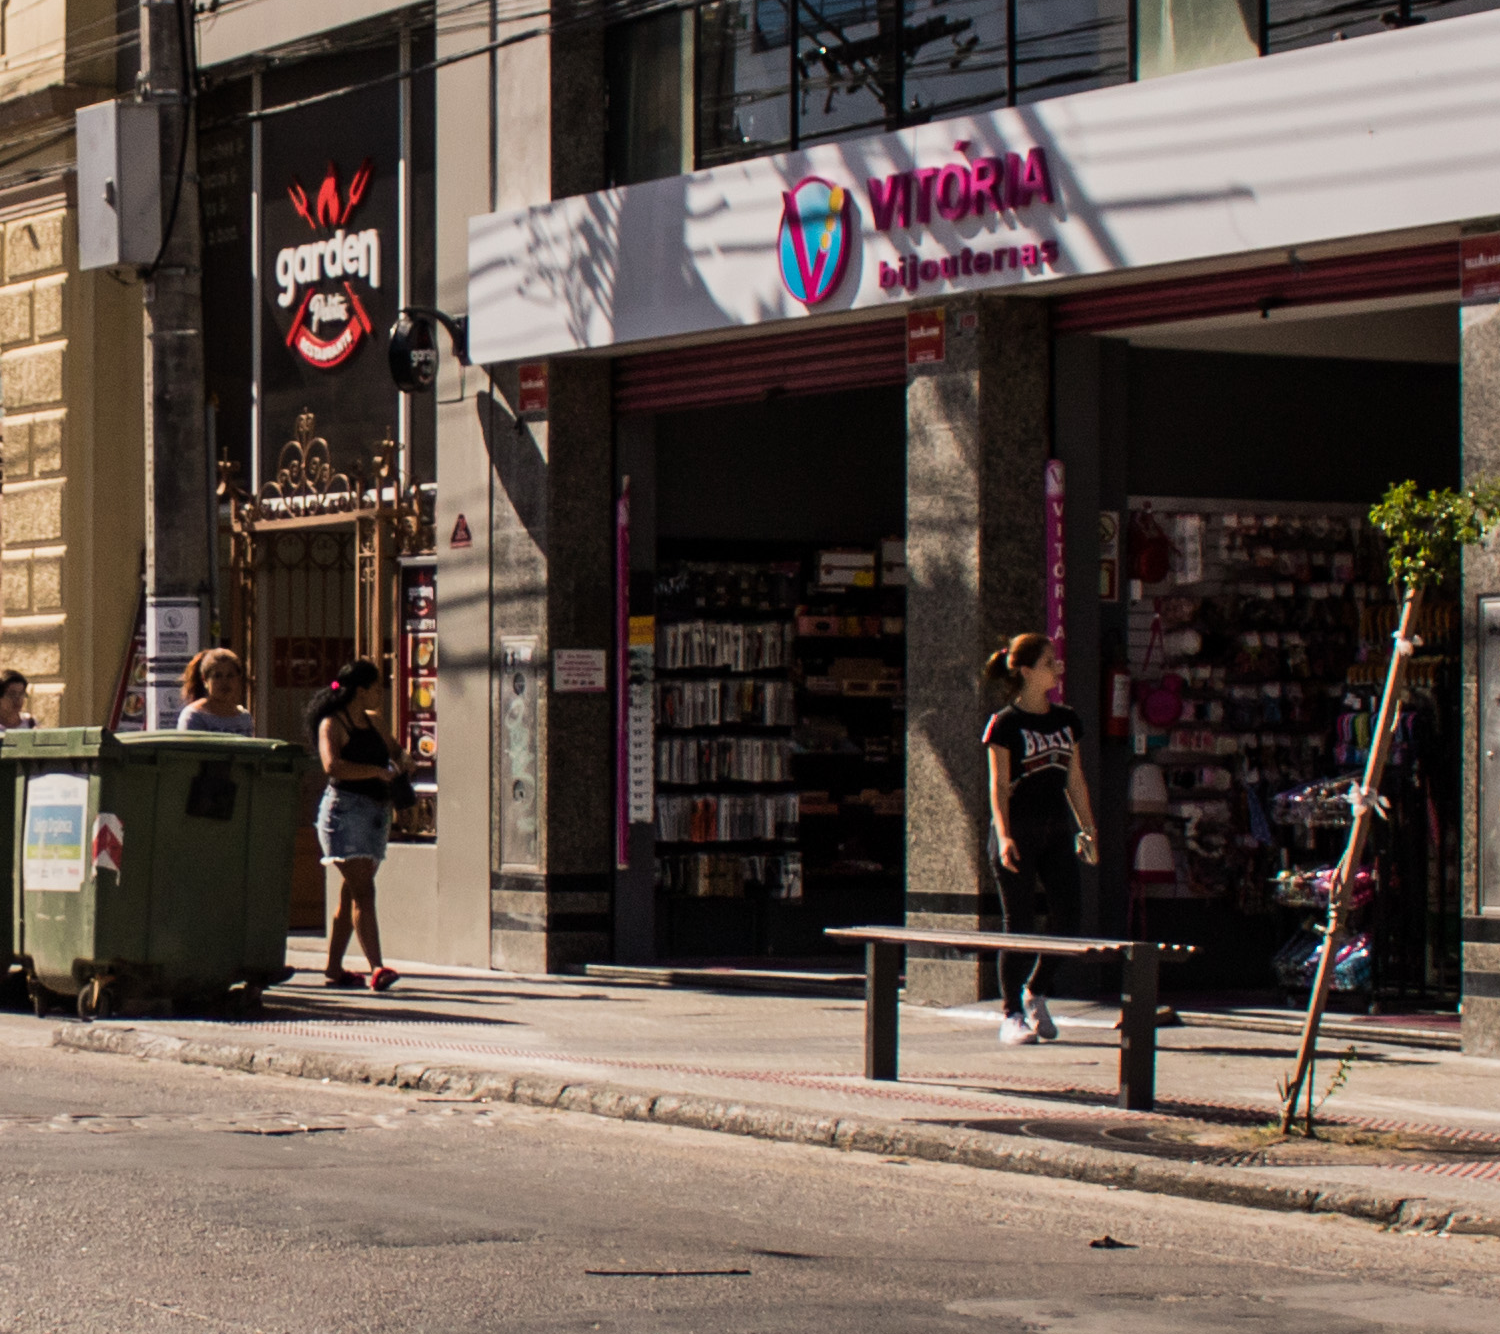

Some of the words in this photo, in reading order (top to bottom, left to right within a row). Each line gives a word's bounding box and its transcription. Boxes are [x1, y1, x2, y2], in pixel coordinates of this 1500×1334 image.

[867, 140, 1055, 231] VITÓRIA
[275, 228, 380, 308] garden
[879, 240, 1060, 292] bijouterias
